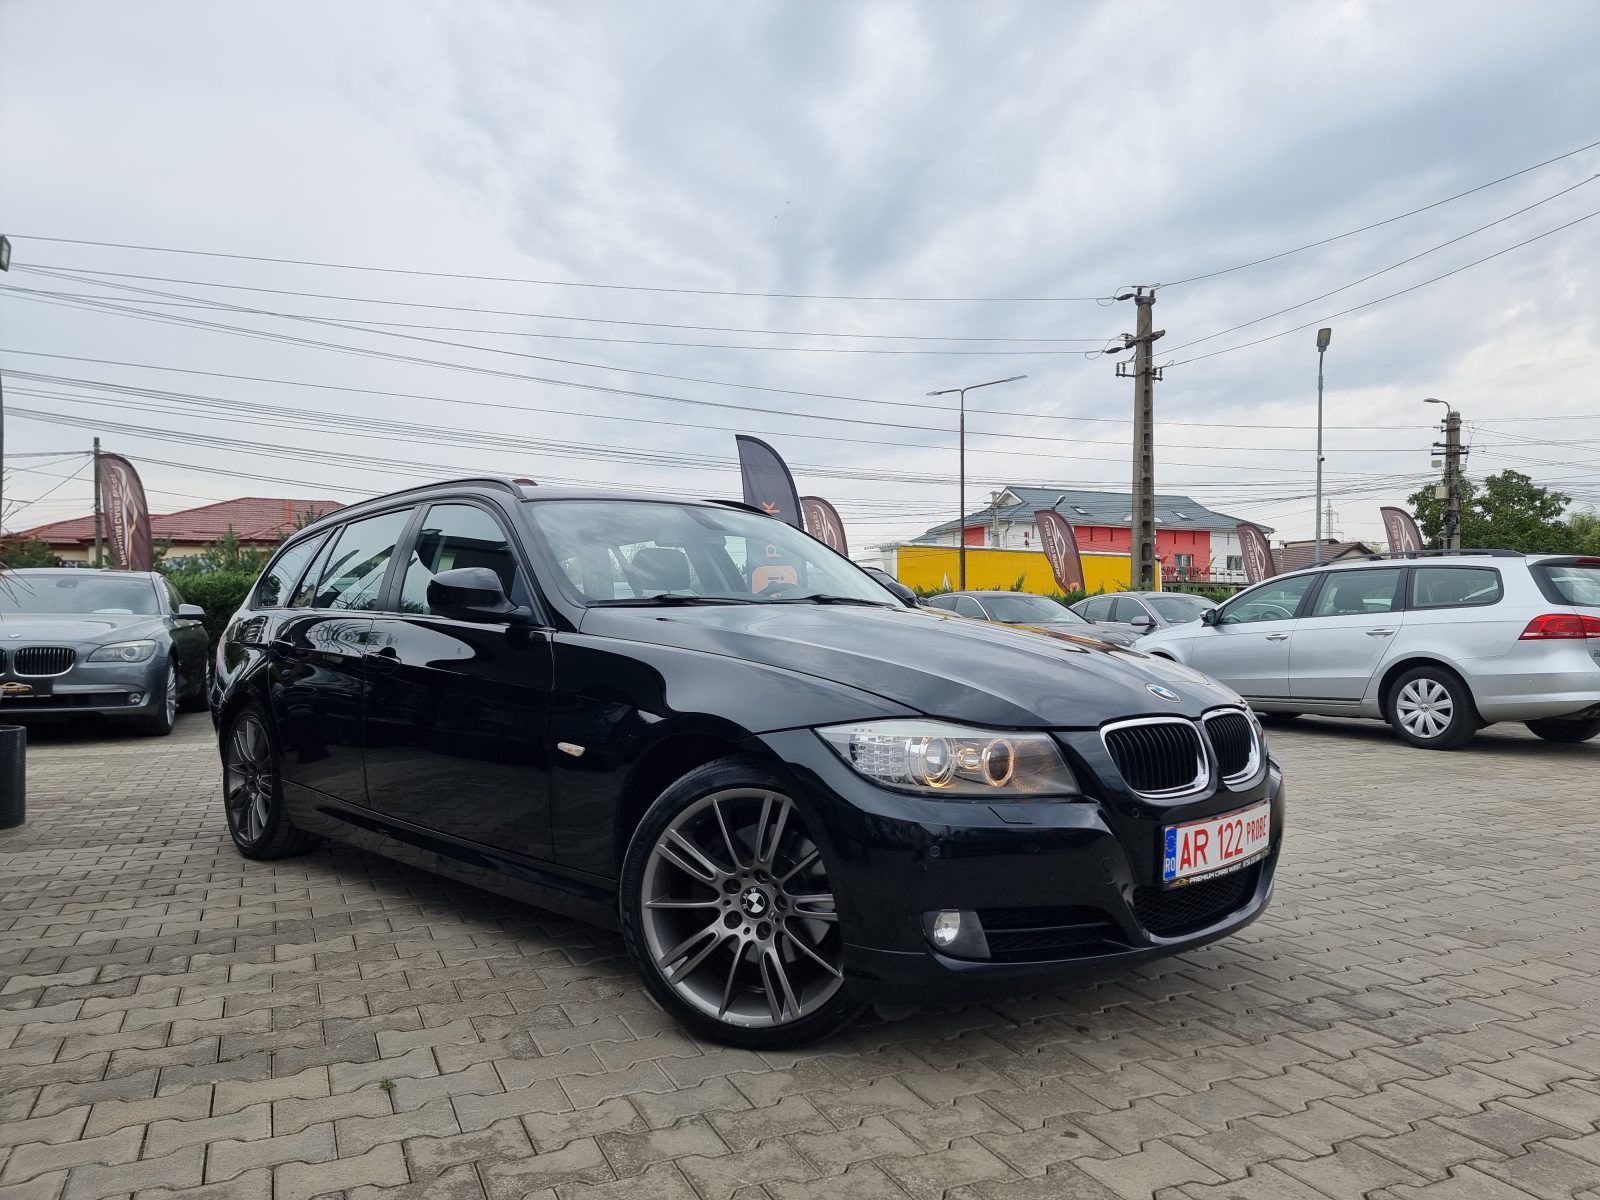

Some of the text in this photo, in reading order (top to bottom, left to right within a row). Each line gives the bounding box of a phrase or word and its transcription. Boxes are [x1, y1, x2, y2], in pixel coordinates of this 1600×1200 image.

[1180, 815, 1267, 870] AR 122 PROBE
[1165, 857, 1176, 873] RO
[1189, 863, 1242, 884] PREMIUM CARS WEST
